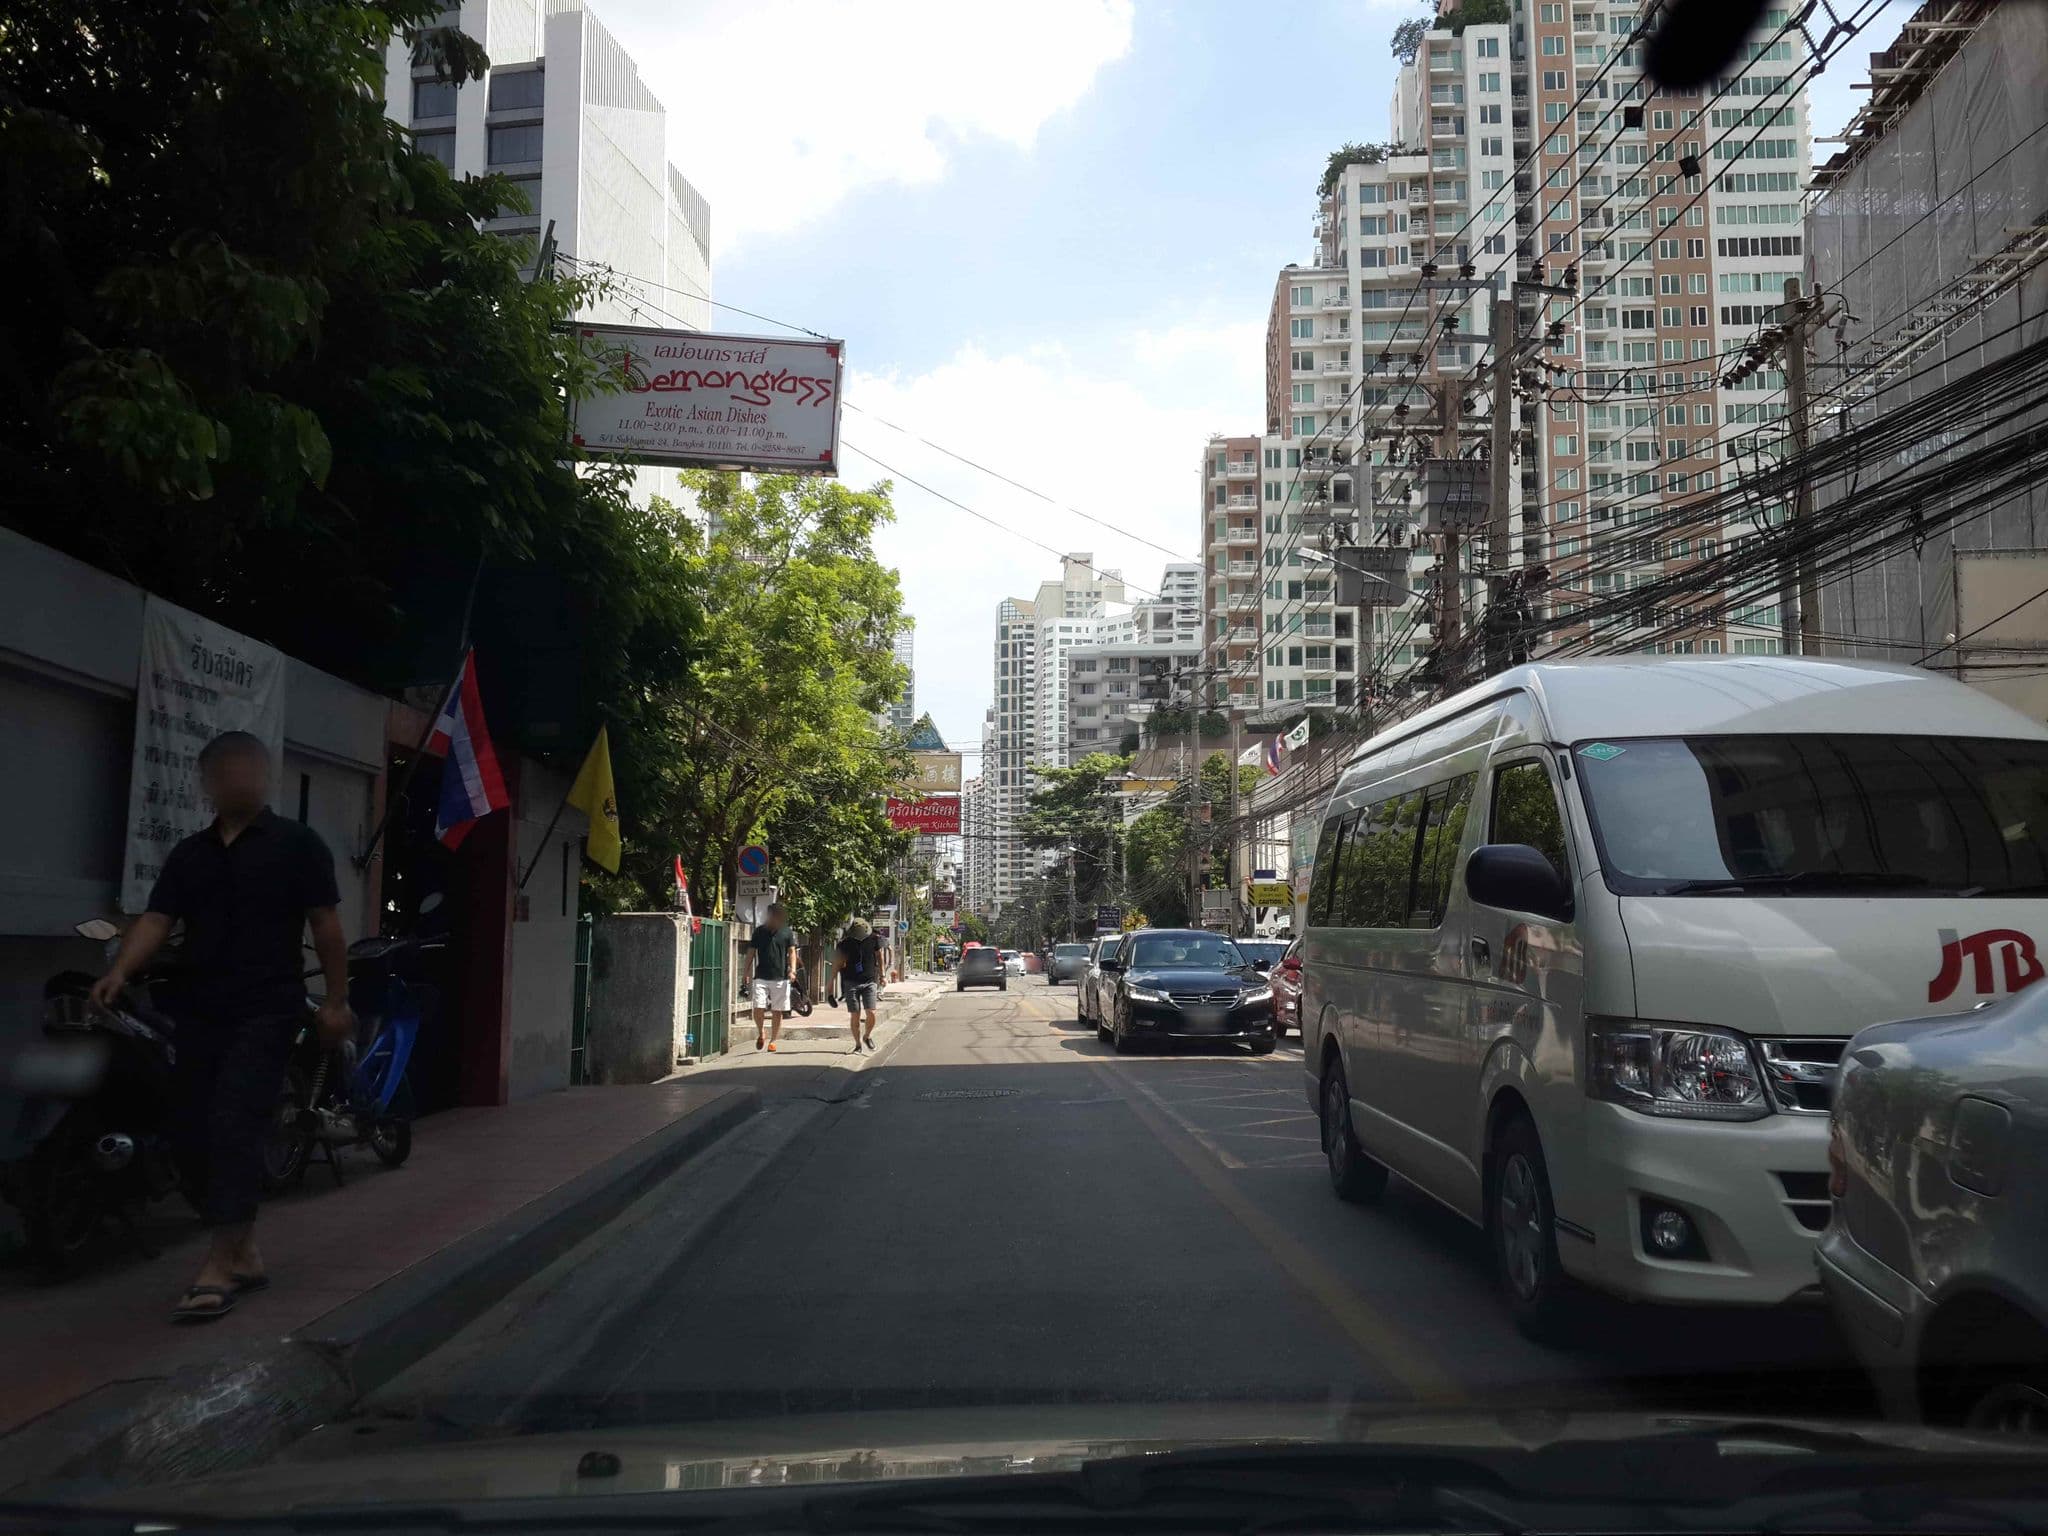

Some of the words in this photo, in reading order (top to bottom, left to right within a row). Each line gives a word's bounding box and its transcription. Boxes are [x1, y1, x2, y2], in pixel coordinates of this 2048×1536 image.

[623, 352, 833, 407] Lemongrass
[645, 402, 683, 419] Exotic
[686, 405, 723, 422] Asian
[727, 407, 767, 424] Dishes
[673, 440, 705, 449] Bangkok
[736, 442, 749, 451] Tel.
[765, 430, 788, 440] p.m.
[191, 635, 255, 688] รับสมัคร
[931, 820, 958, 831] Kitchen
[1928, 928, 2045, 1003] JTB
